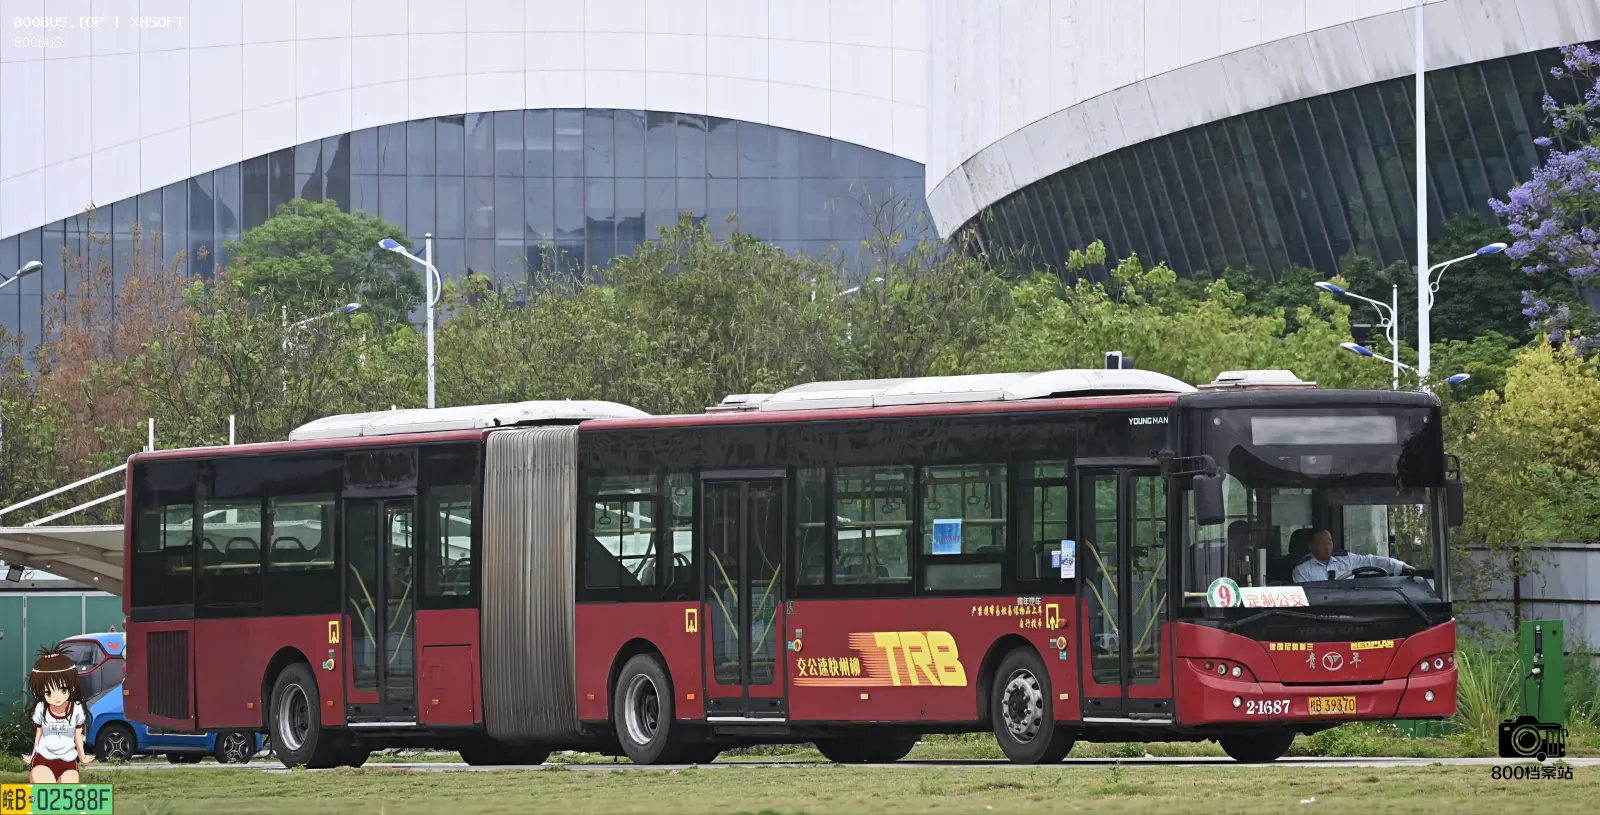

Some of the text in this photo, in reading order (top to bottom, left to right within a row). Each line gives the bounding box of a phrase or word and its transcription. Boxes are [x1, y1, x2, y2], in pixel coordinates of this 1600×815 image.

[1128, 416, 1169, 425] YOUNG MAN
[1218, 585, 1231, 607] 9
[1246, 592, 1305, 608] 定制公交
[1350, 640, 1394, 651] NEOPLAN
[873, 630, 968, 687] TRB
[1246, 699, 1290, 715] 2-1687
